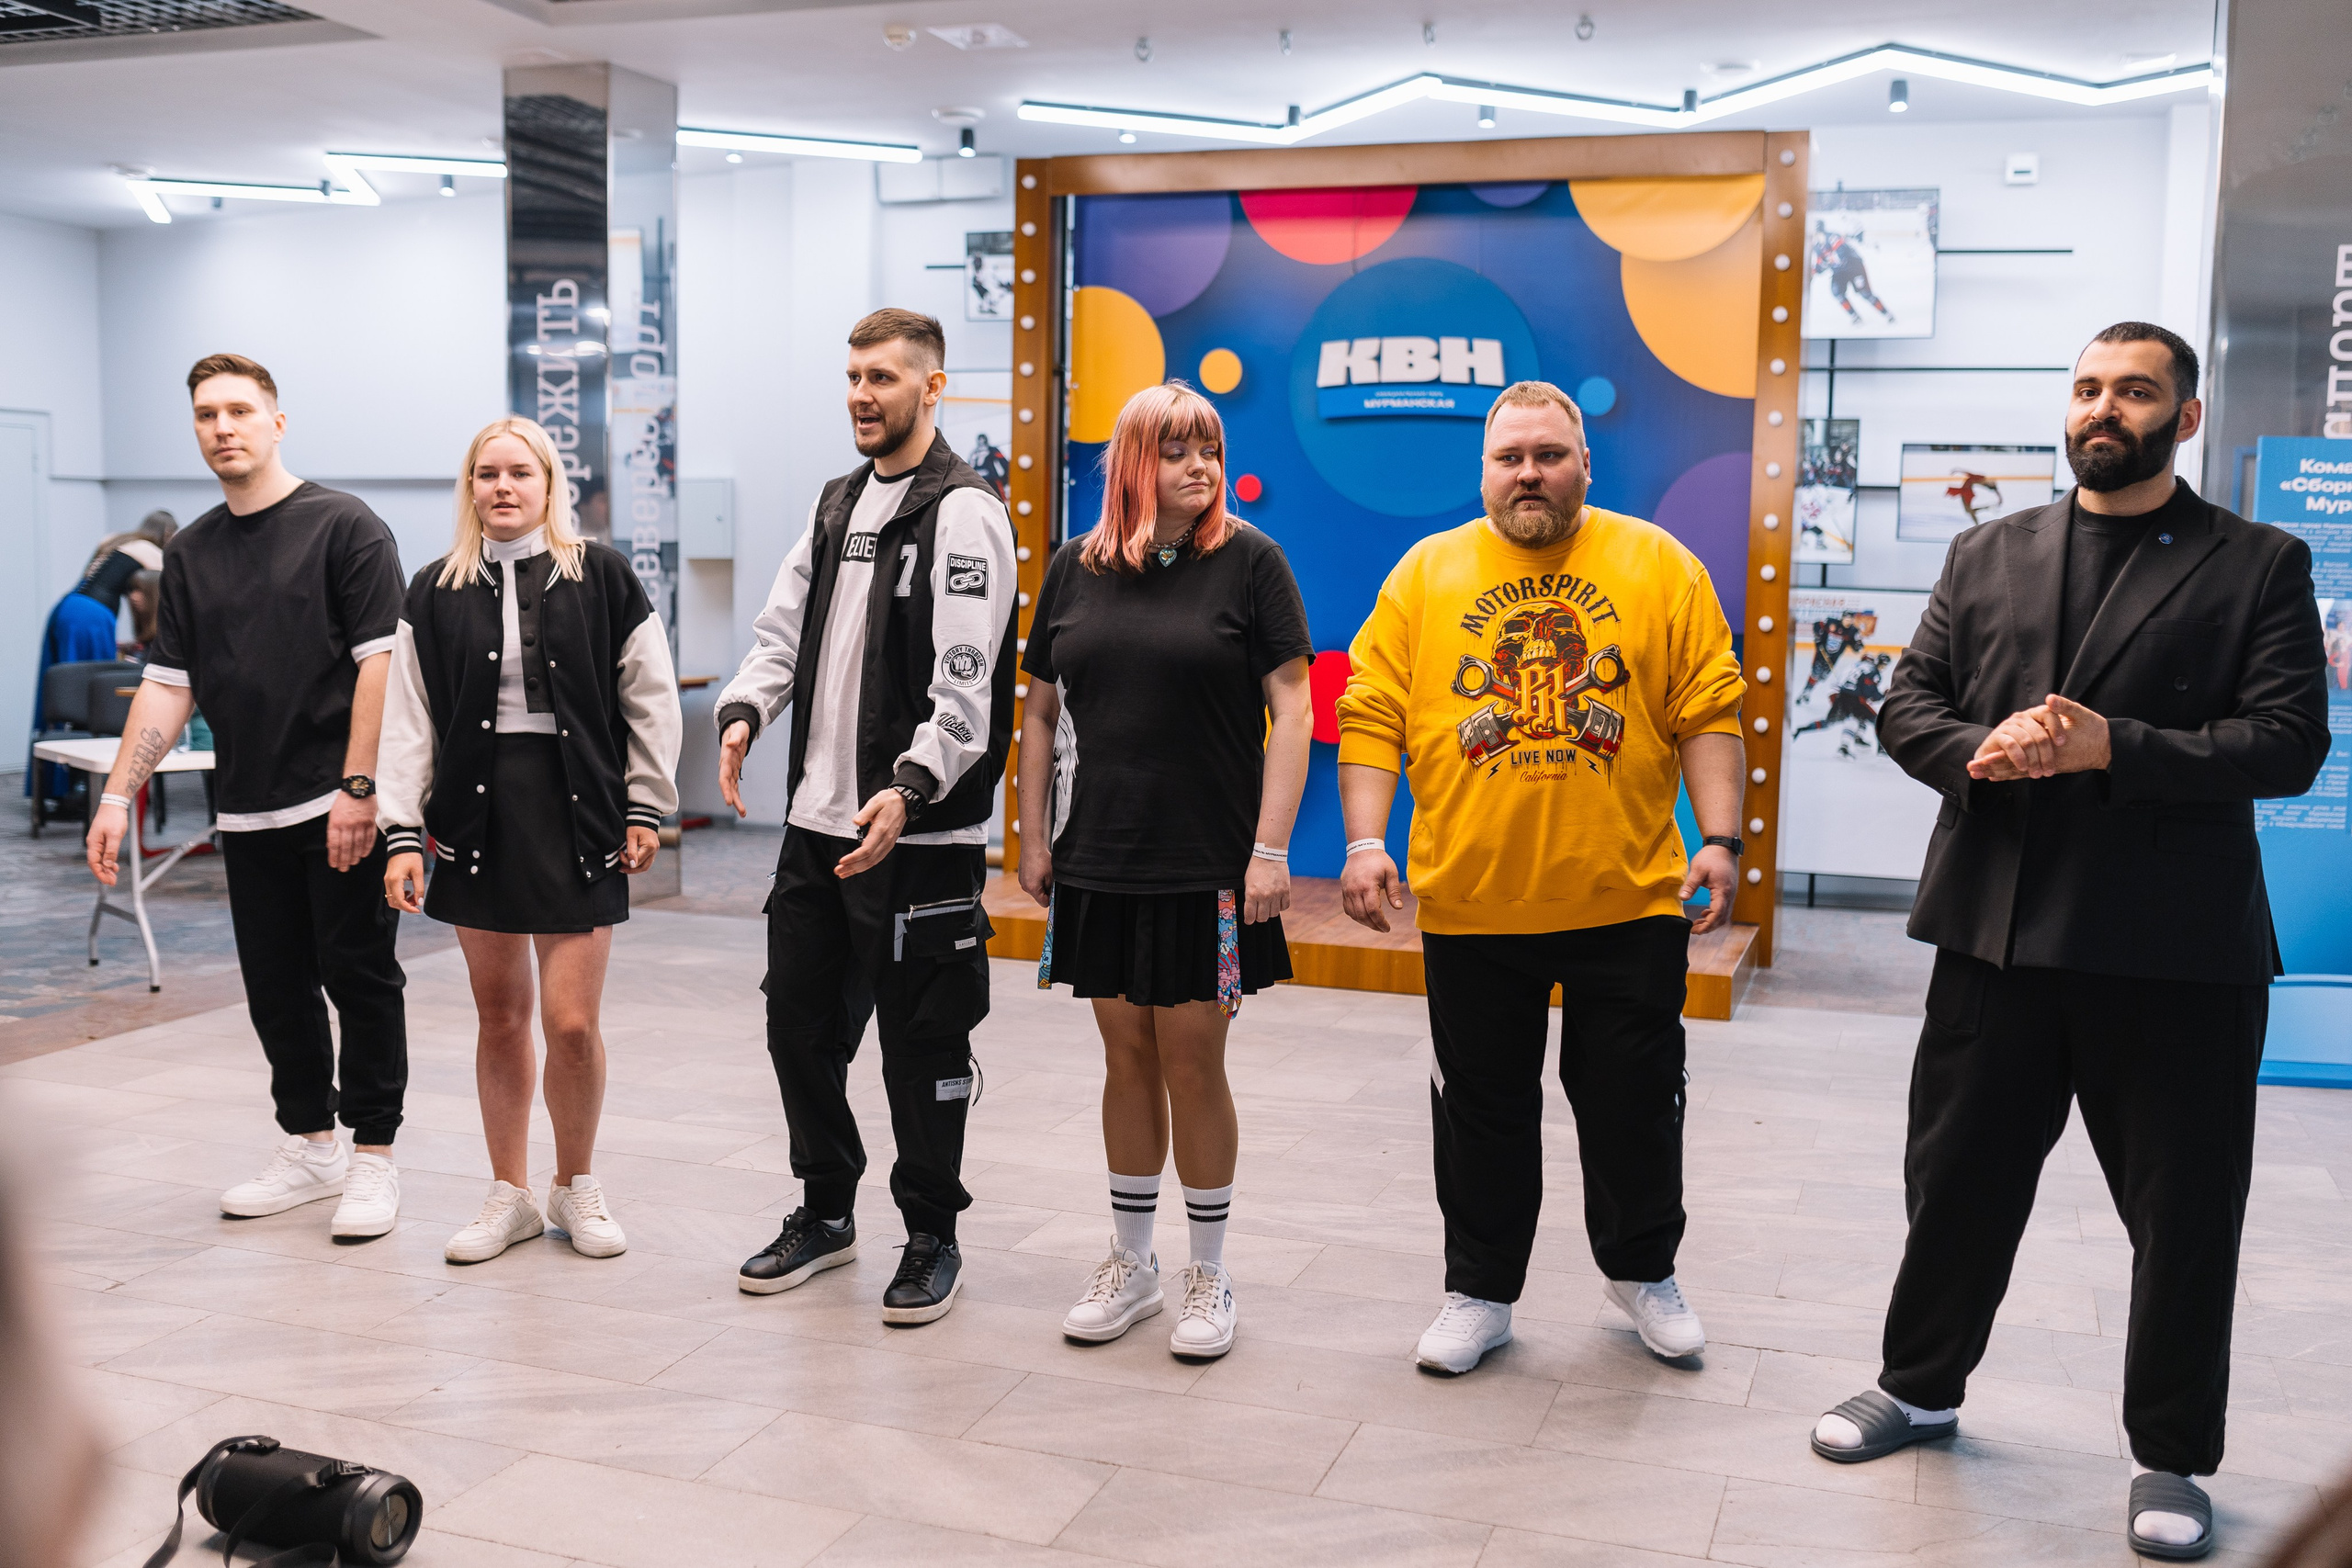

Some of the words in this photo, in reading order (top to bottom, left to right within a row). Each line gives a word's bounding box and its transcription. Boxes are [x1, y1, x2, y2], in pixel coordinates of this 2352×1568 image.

[1317, 336, 1505, 388] КВН
[894, 544, 918, 597] 7
[950, 557, 987, 572] DISCIPLINE
[1460, 573, 1622, 638] MOTORSPIRIT
[944, 647, 963, 664] VICTORY
[965, 647, 984, 667] THROUGH
[1510, 750, 1540, 765] LIVE
[1546, 749, 1577, 763] NOW
[1519, 770, 1568, 785] California
